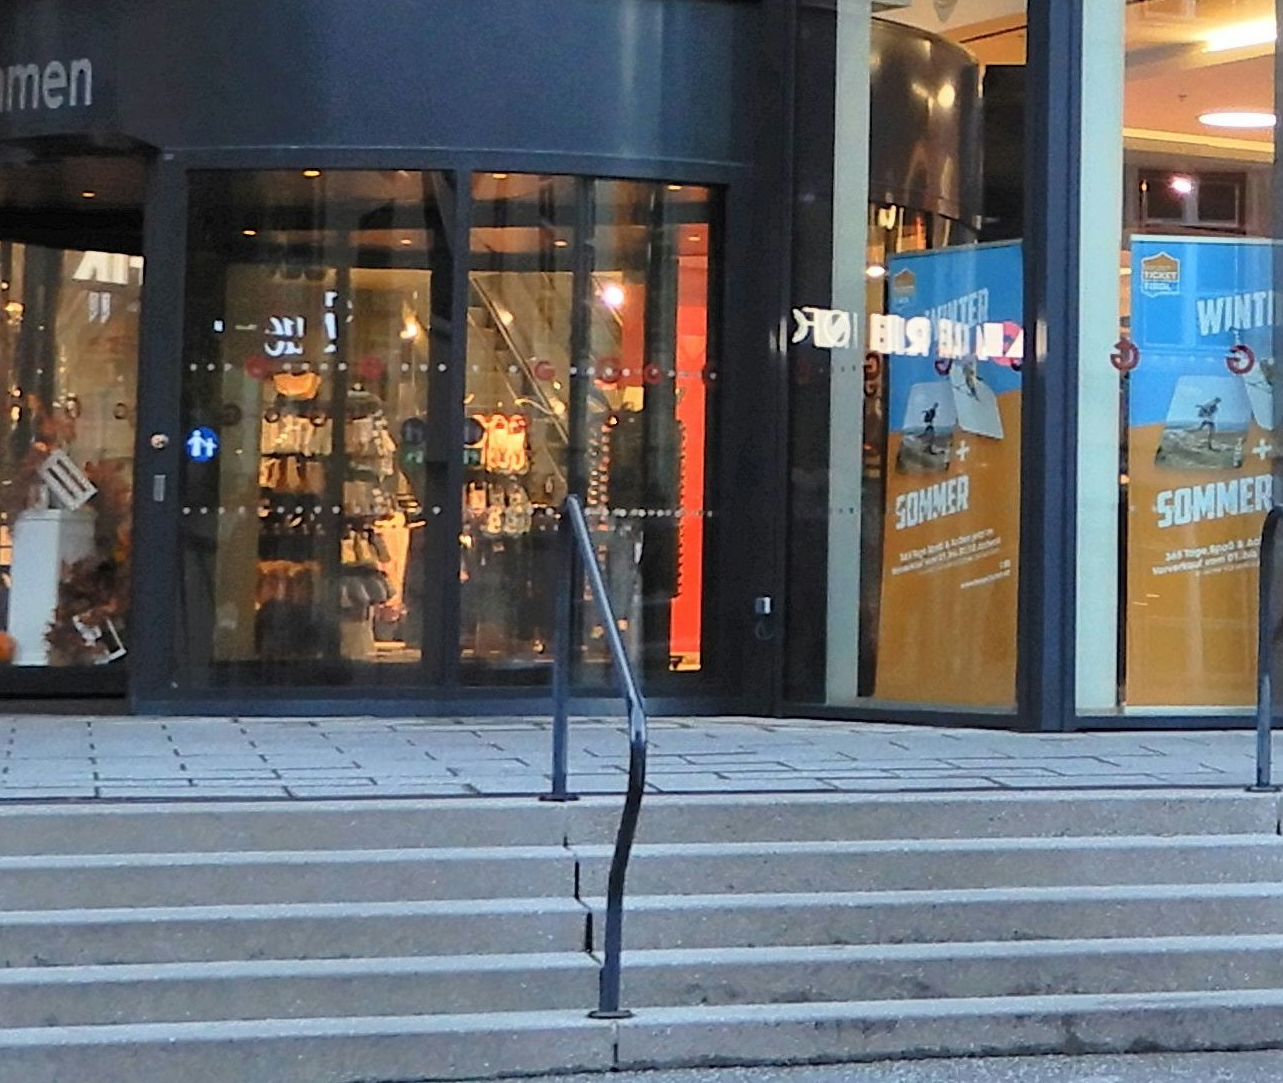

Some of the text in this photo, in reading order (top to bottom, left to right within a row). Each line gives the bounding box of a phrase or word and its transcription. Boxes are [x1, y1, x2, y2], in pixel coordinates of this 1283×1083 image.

[1197, 290, 1274, 337] WINT
[896, 476, 969, 530] SOMMER
[1156, 474, 1275, 529] SOMMER
